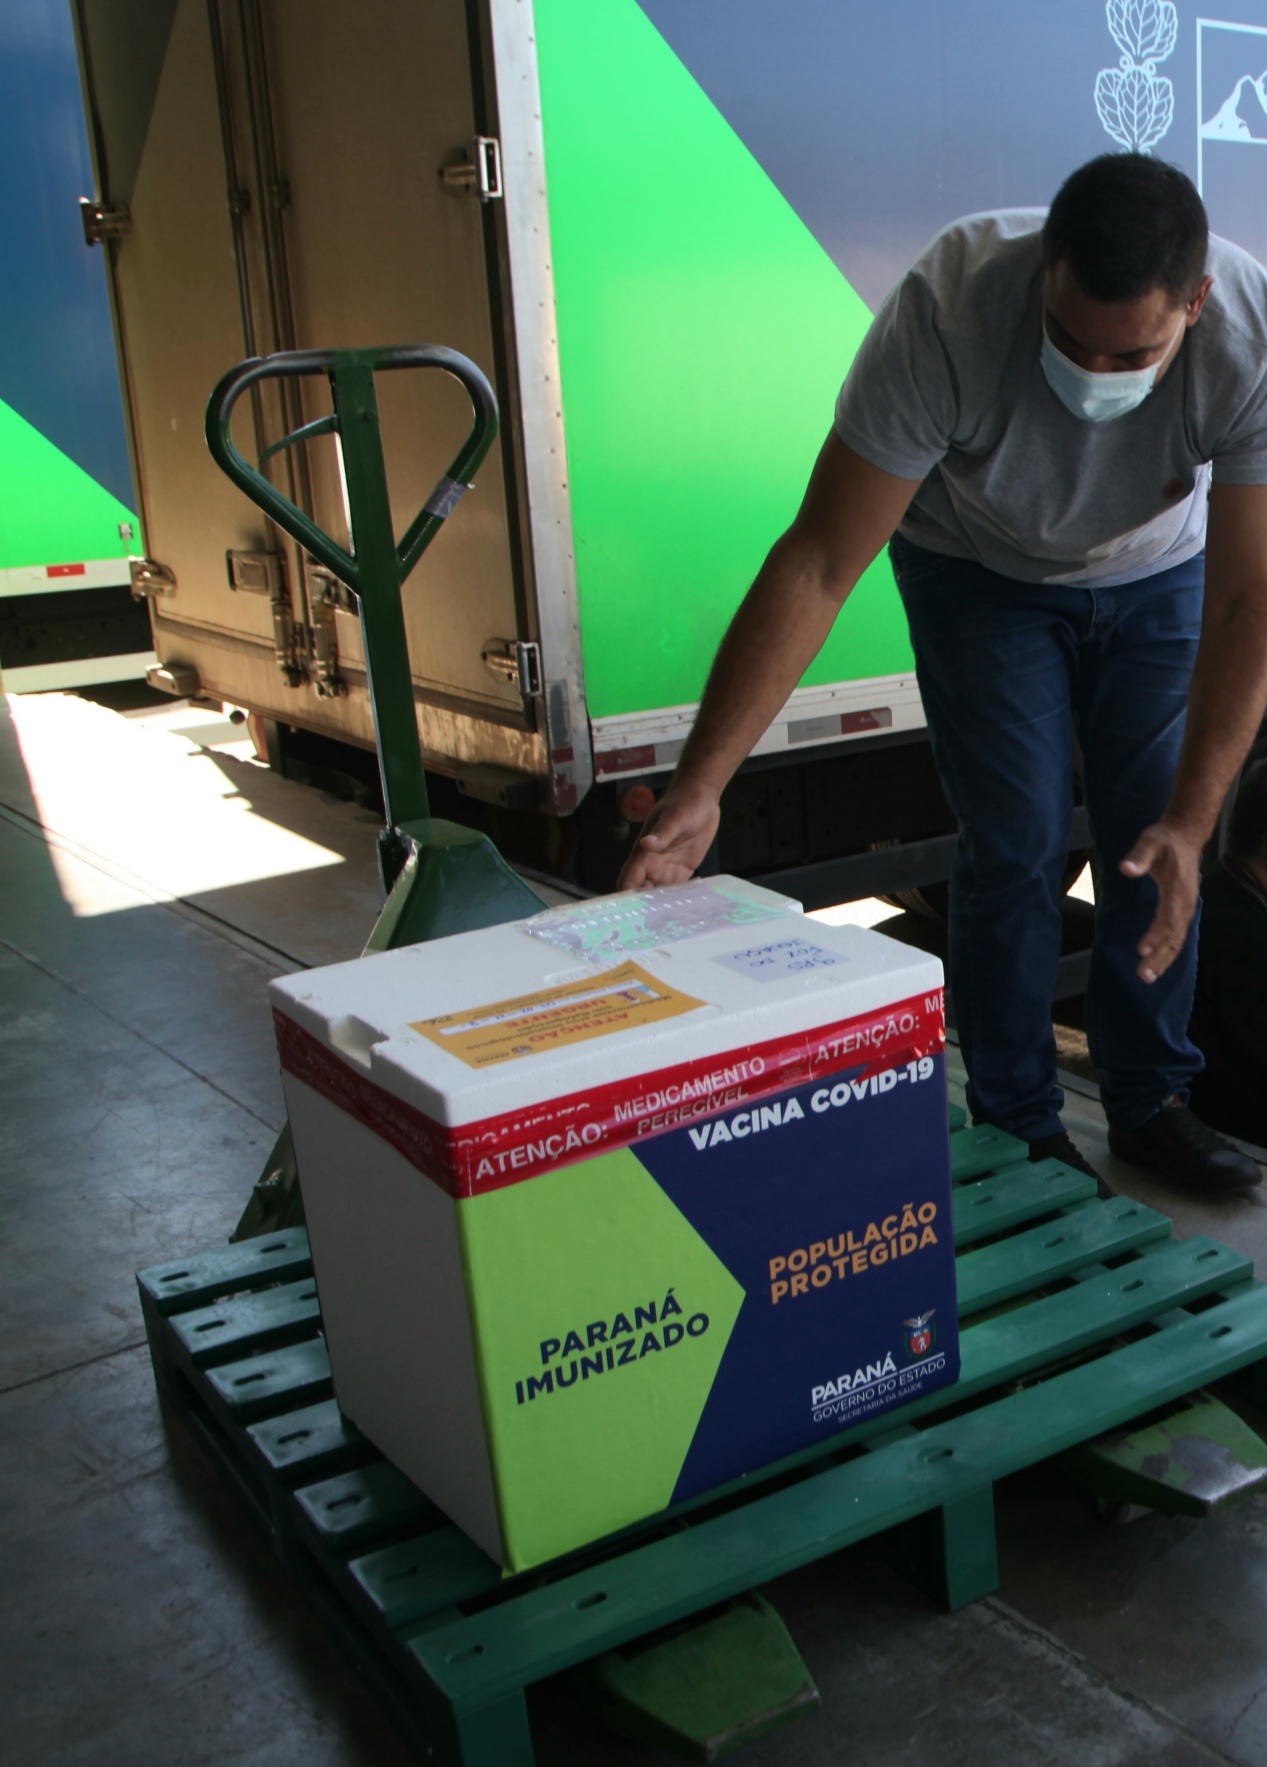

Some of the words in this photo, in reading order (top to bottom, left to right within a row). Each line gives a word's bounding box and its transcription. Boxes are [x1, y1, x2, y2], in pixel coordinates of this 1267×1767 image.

[505, 998, 607, 1029] URGENTE
[528, 1012, 630, 1043] ATENÇÃO
[476, 1123, 608, 1180] ATENÇÃO:
[613, 1056, 766, 1122] MEDICAMENTO
[814, 1013, 921, 1064] ATENÇÃO:
[637, 1085, 749, 1136] PERECÍVEL
[688, 1097, 805, 1151] VACINA
[811, 1056, 935, 1114] COVID-19
[769, 1202, 938, 1281] POPULAÇÃO
[771, 1225, 939, 1305] PROTEGIDA
[515, 1312, 710, 1406] IMUNIZADO
[539, 1287, 683, 1366] PARANÁ
[811, 1351, 898, 1406] PARANÁ
[813, 1388, 875, 1423] GOVERNO
[877, 1379, 897, 1395] DO
[899, 1358, 946, 1386] ESTADO
[838, 1399, 885, 1424] SECRETARIA
[886, 1393, 897, 1403] DA
